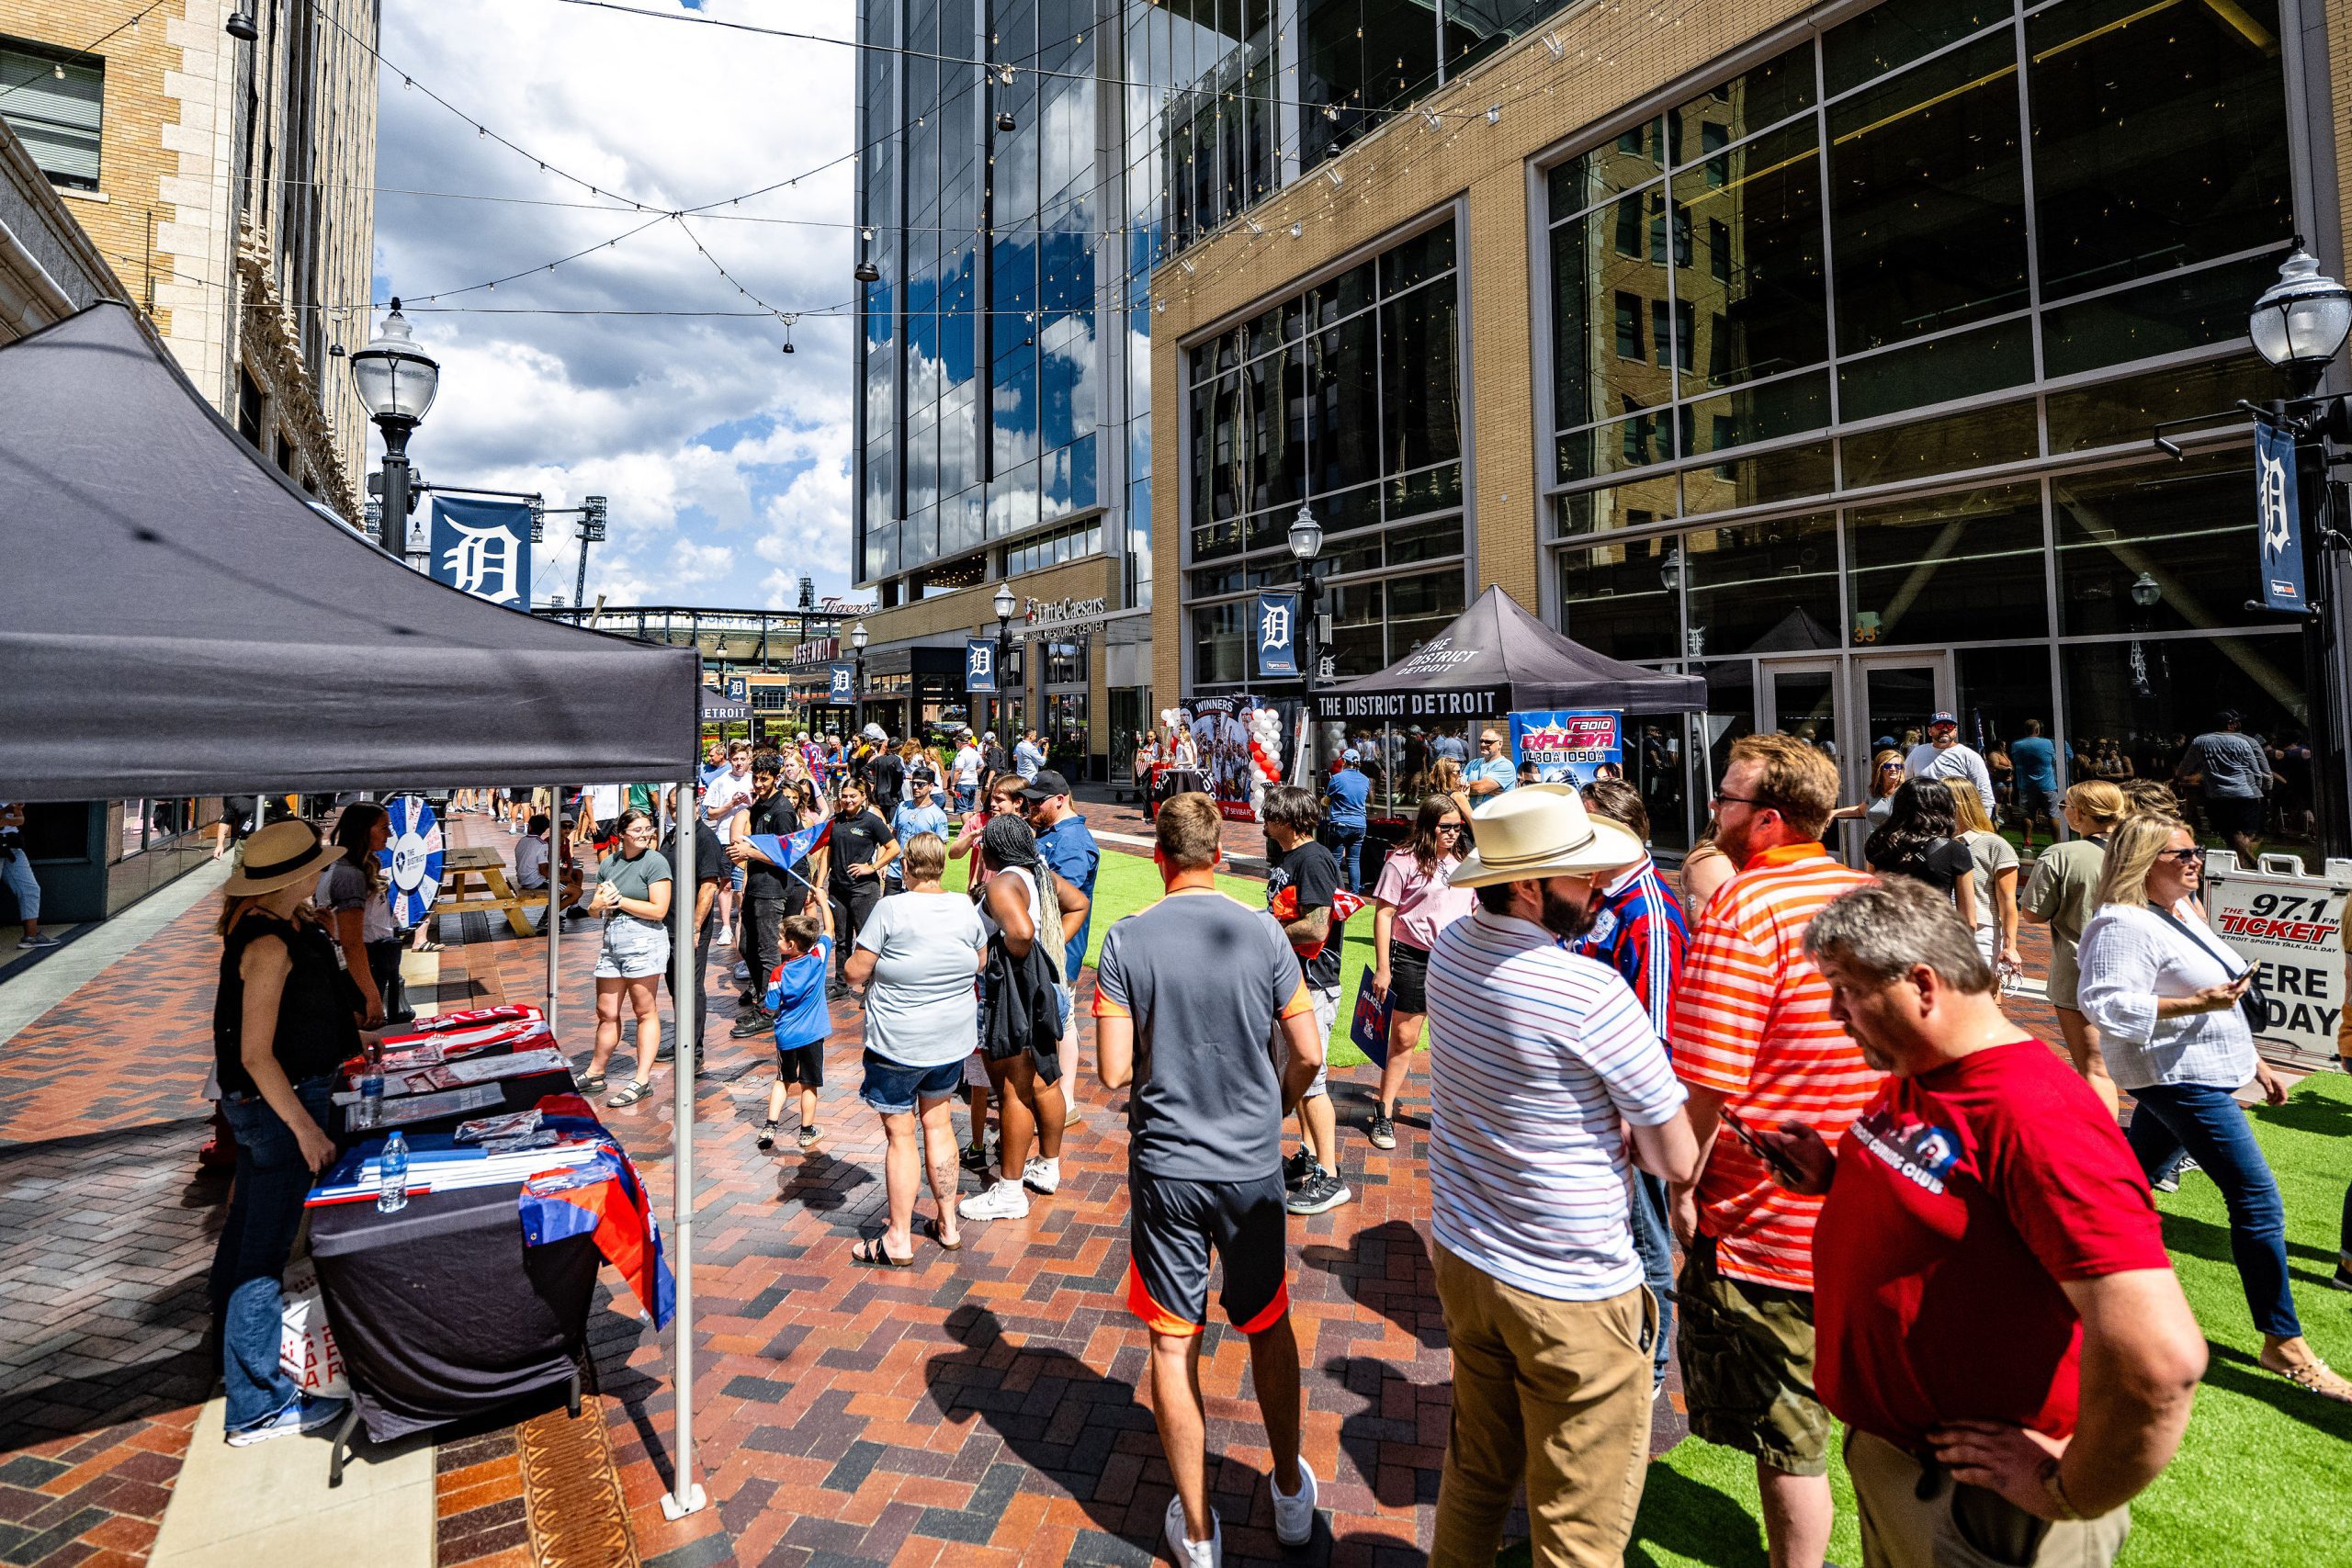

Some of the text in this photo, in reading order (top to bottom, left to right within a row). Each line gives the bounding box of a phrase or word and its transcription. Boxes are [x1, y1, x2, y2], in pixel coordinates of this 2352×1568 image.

[821, 596, 872, 615] Tigers
[1037, 597, 1103, 625] Little Caesars
[1023, 620, 1104, 643] GLOBAL RESOURCE CENTER
[792, 637, 831, 666] ASSEMBLY
[1422, 637, 1453, 654] THE
[1407, 650, 1480, 667] DISTRICT
[1396, 664, 1456, 676] DETROIT
[1195, 698, 1233, 713] WINNERS
[1318, 692, 1496, 716] THE DISTRICT DETROIT
[811, 749, 822, 764] 26
[1522, 751, 1552, 763] 1480
[1564, 751, 1597, 763] 1090
[2223, 907, 2245, 915] THE
[2249, 893, 2329, 923] 97.1
[2218, 914, 2340, 945] TICKET
[2250, 938, 2280, 946] SPORTS
[2245, 960, 2328, 999] ERE
